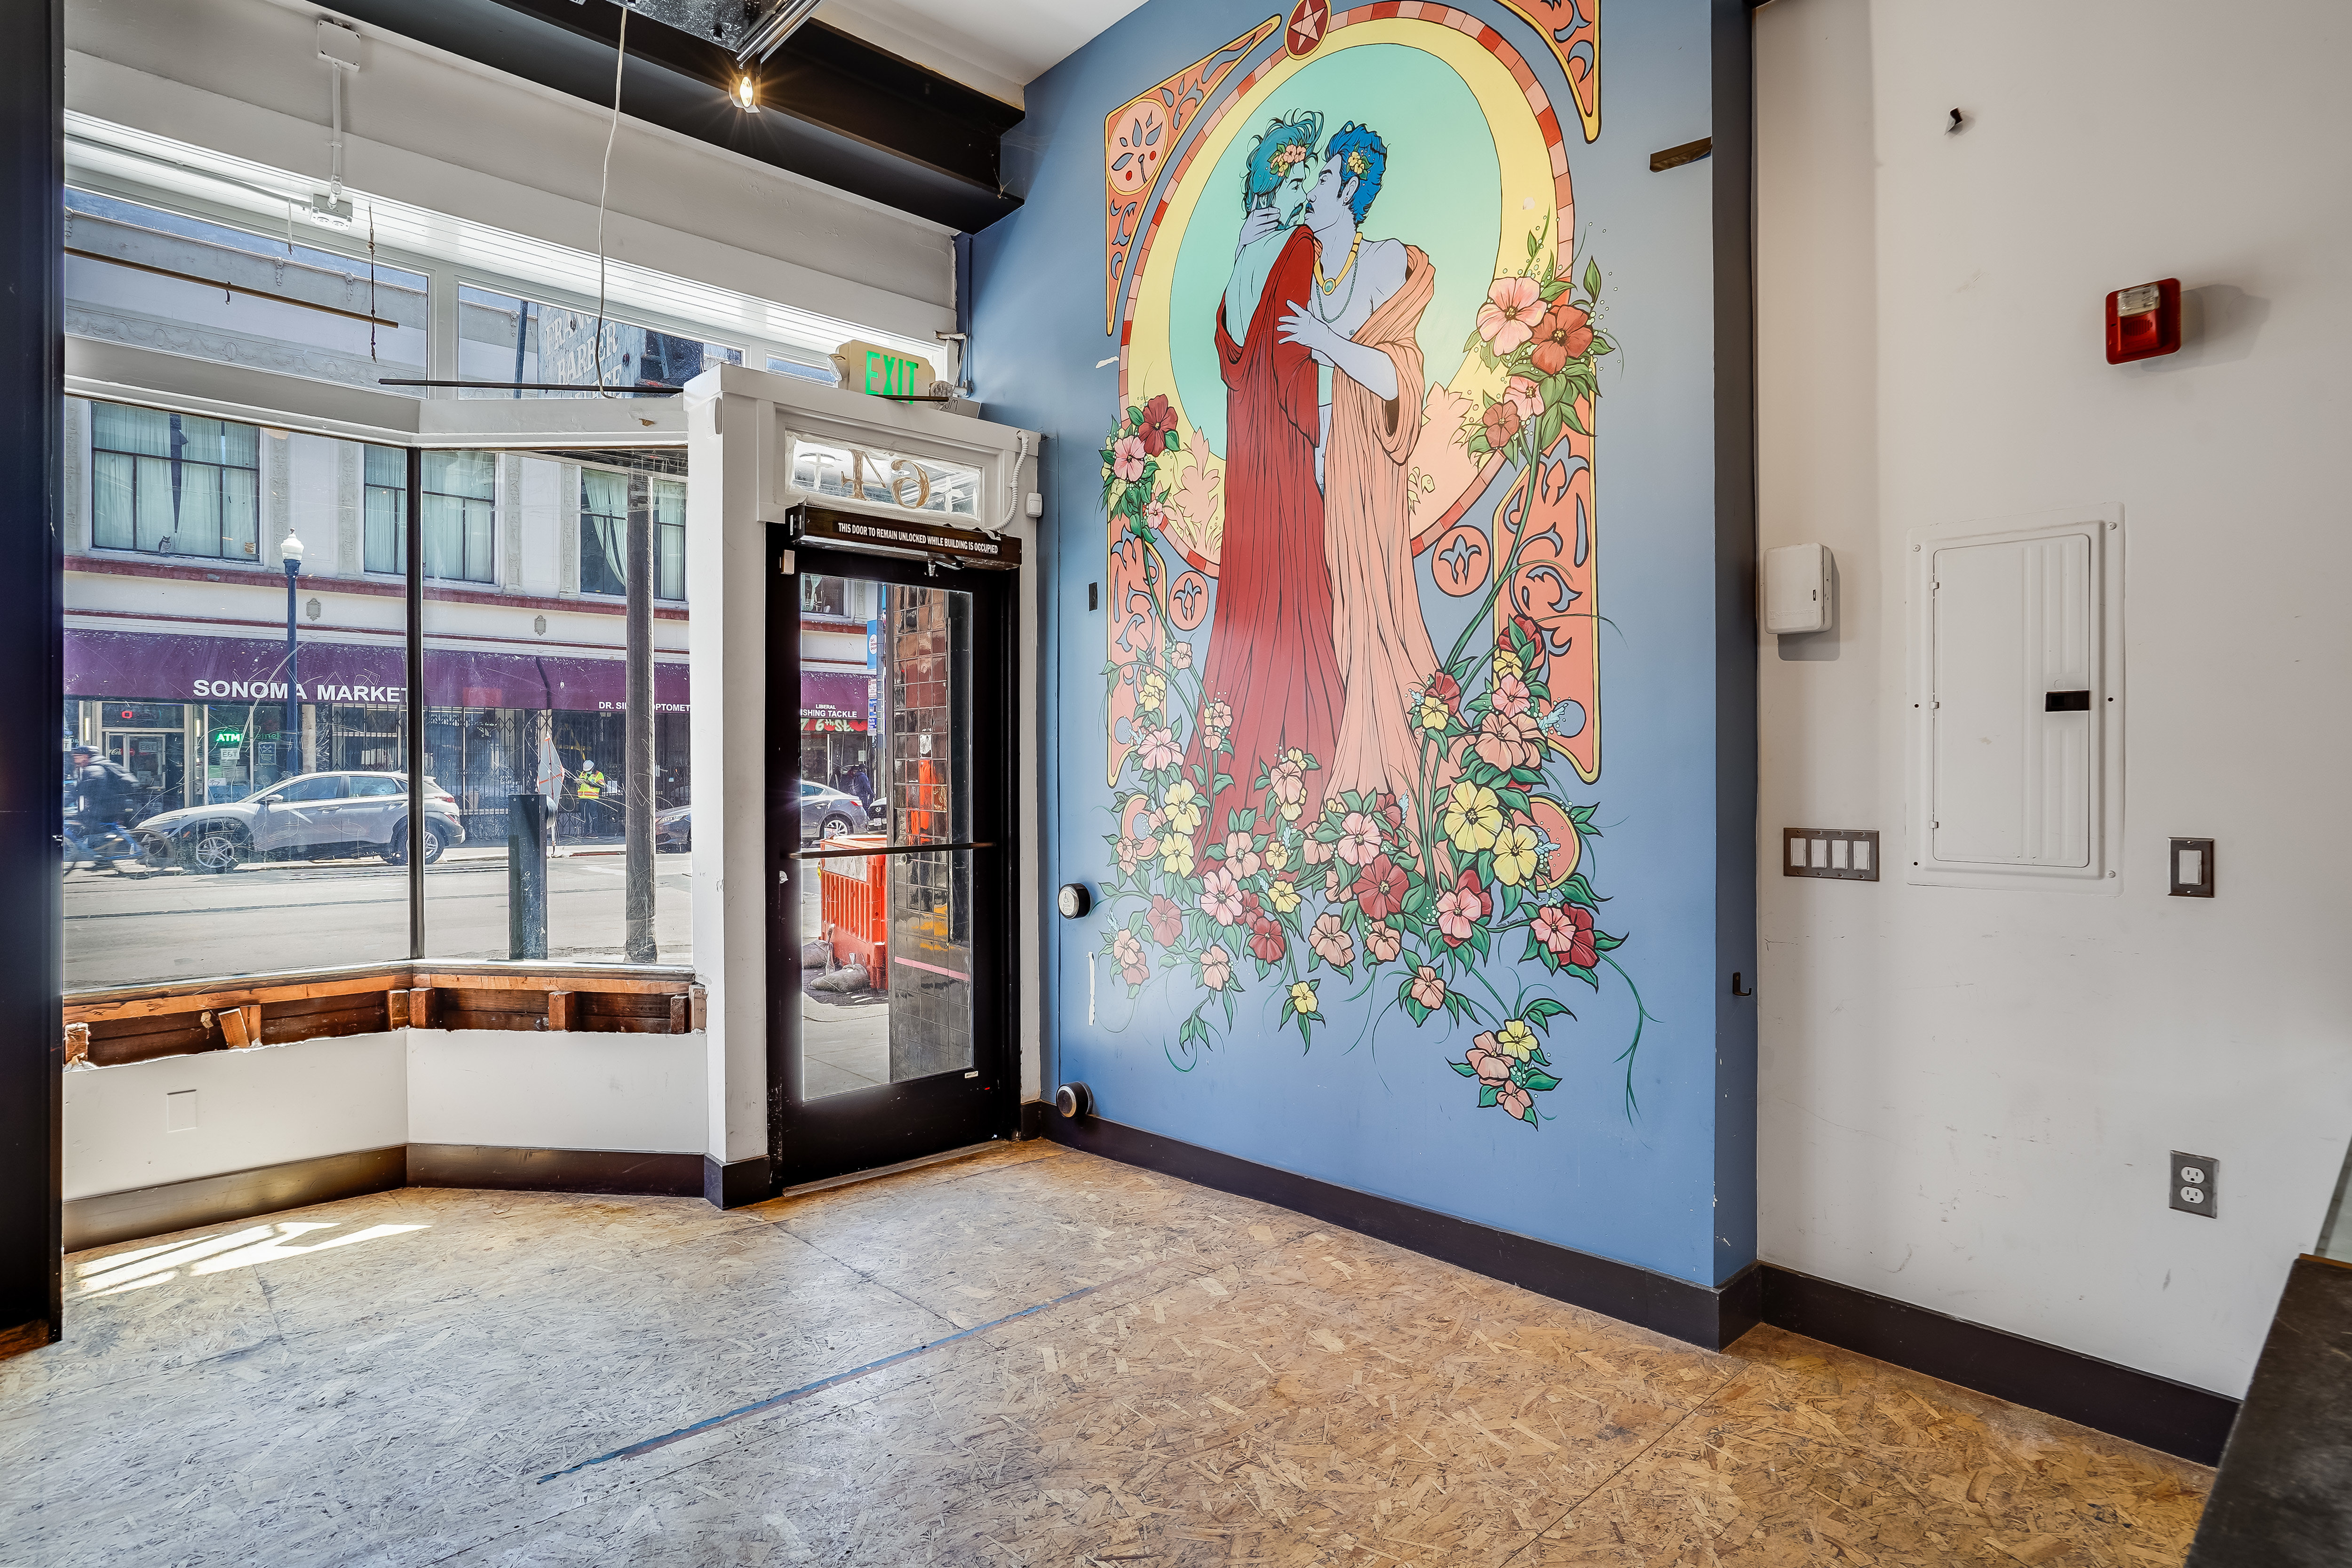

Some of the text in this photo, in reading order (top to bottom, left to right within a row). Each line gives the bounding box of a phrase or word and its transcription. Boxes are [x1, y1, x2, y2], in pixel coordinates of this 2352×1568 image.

[557, 321, 619, 386] BARBER
[866, 350, 919, 405] EXIT
[838, 522, 998, 554] THIS DOOR TO REMAIN UNLOCKED WHILE BUILDING IS OCCUPIED
[193, 679, 408, 702] SONOMA MARKET
